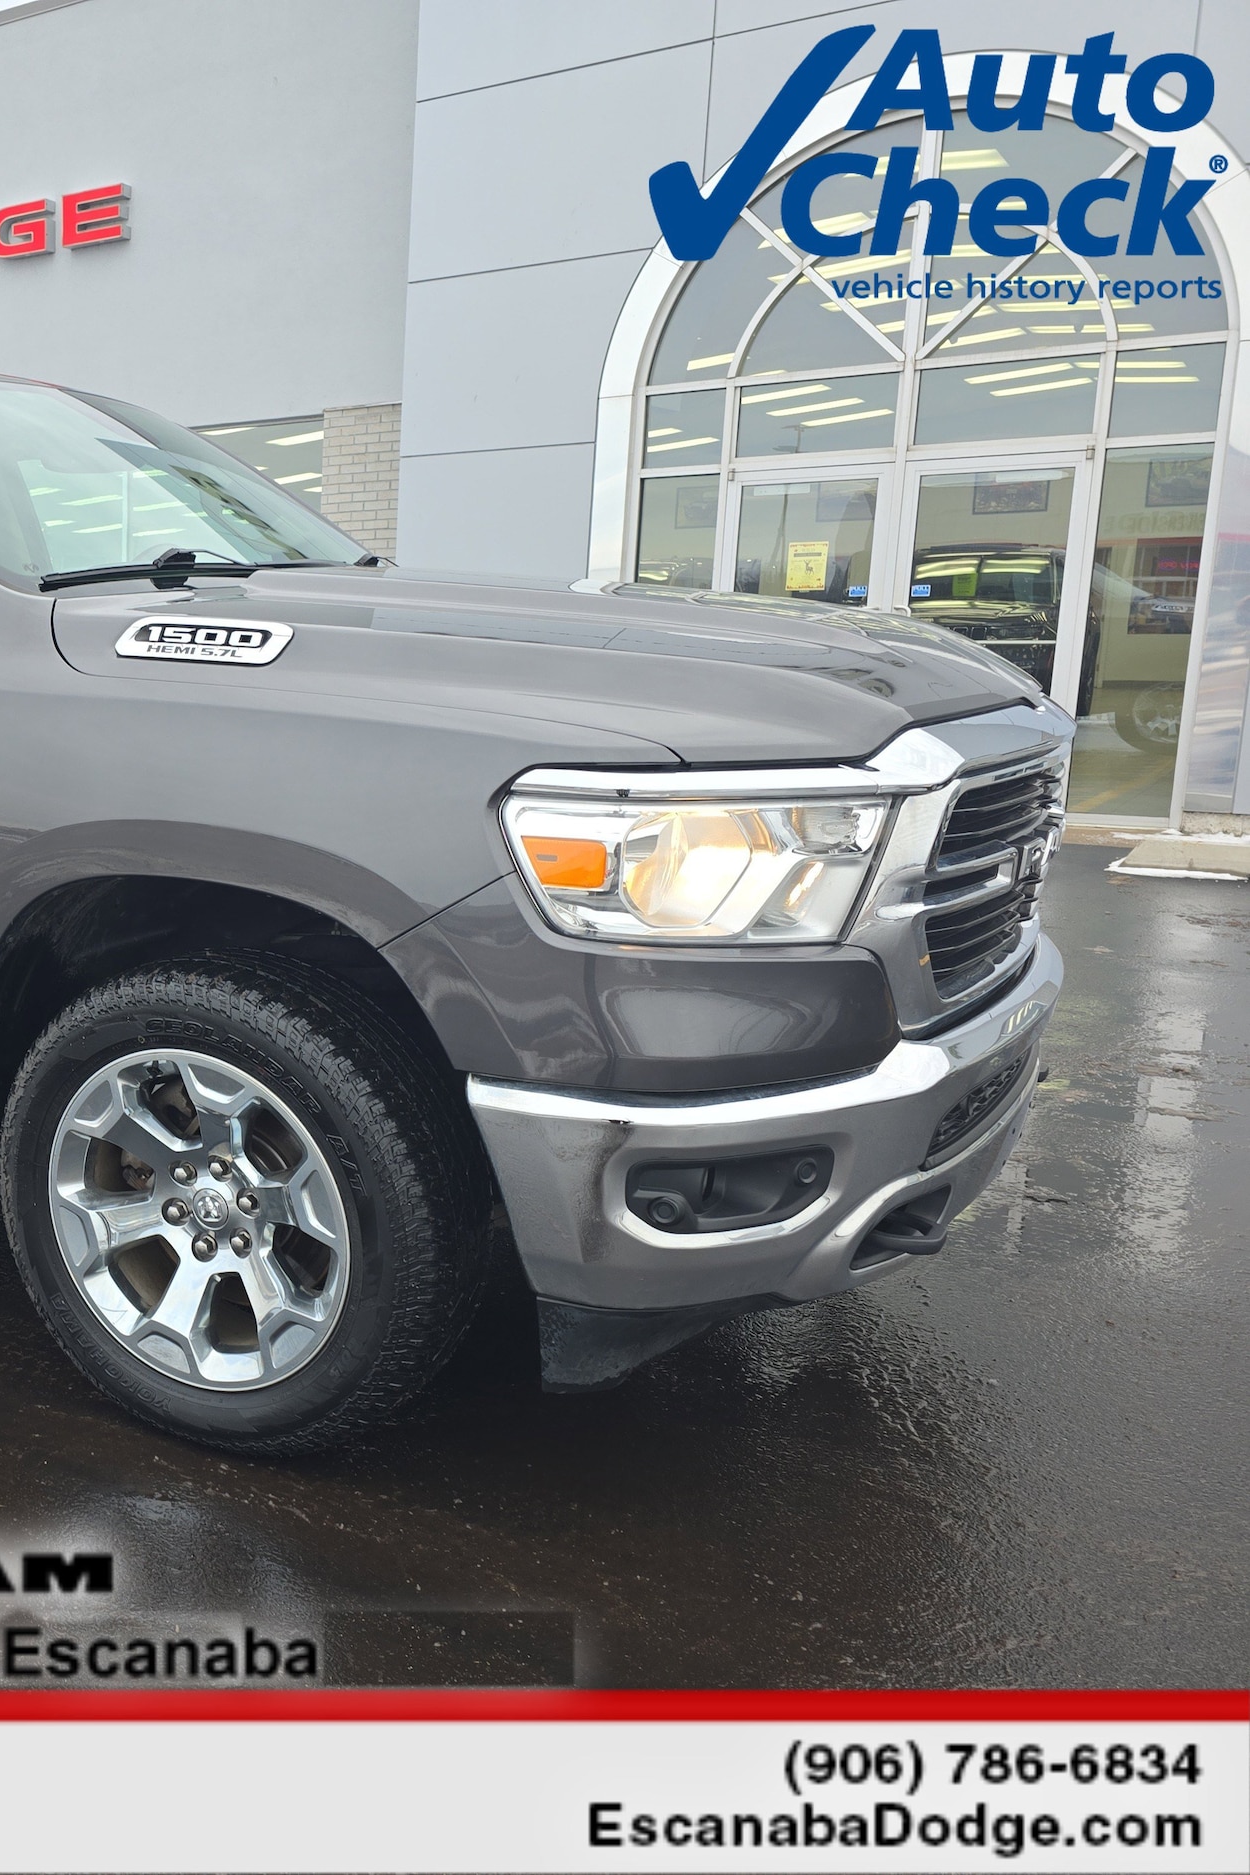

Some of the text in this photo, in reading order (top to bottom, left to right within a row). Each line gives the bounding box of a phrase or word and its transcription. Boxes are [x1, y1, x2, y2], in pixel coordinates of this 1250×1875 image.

[147, 625, 264, 648] 1500
[146, 644, 244, 659] HEMI 5.7L
[144, 1017, 323, 1115] GEOLANDAR
